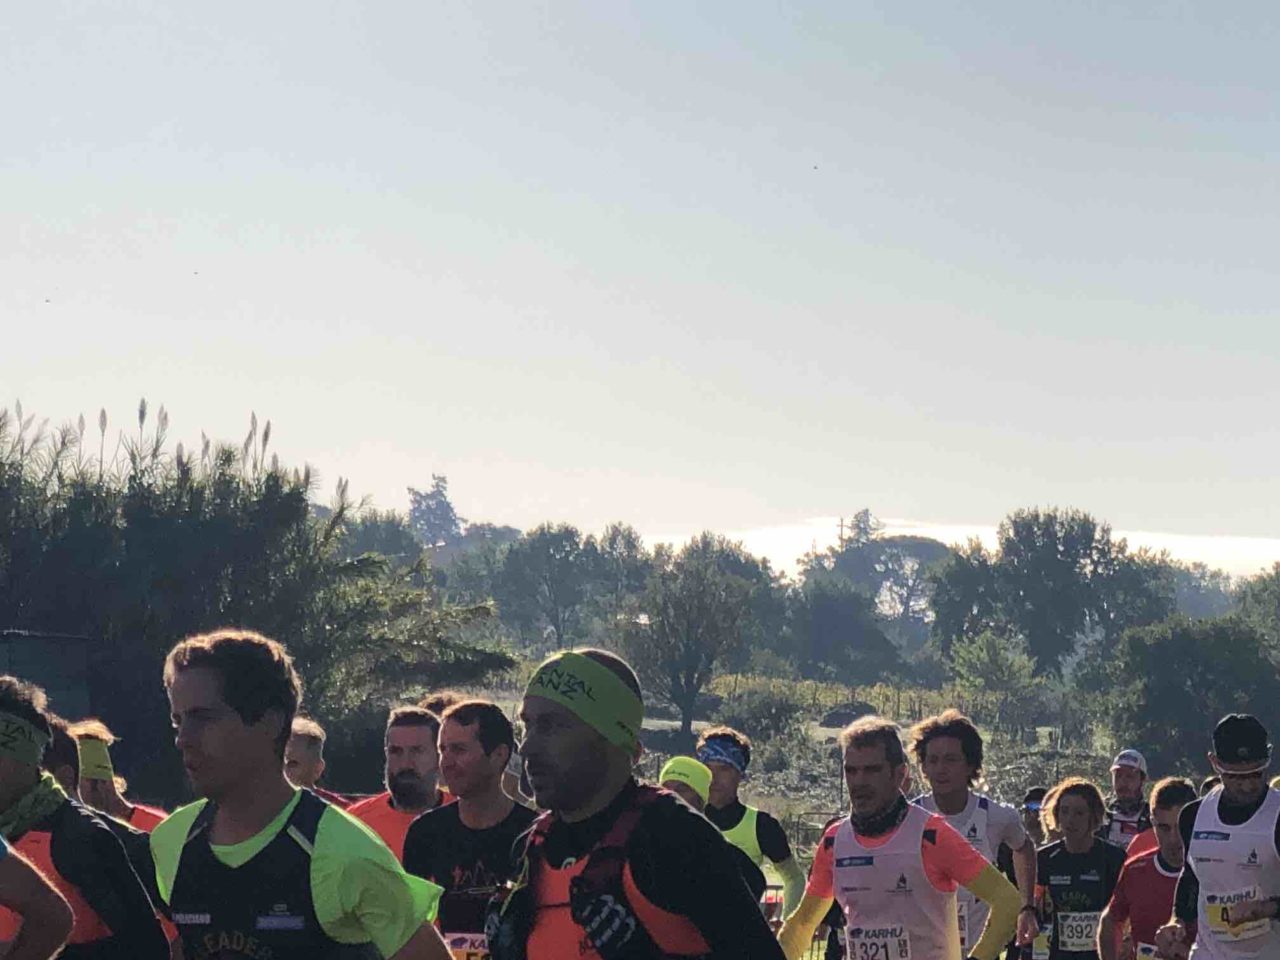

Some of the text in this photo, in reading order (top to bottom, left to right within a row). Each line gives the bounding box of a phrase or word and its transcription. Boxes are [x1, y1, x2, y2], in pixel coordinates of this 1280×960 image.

[1219, 888, 1257, 905] KARHU
[864, 926, 903, 939] KARHU
[1066, 923, 1093, 940] 392
